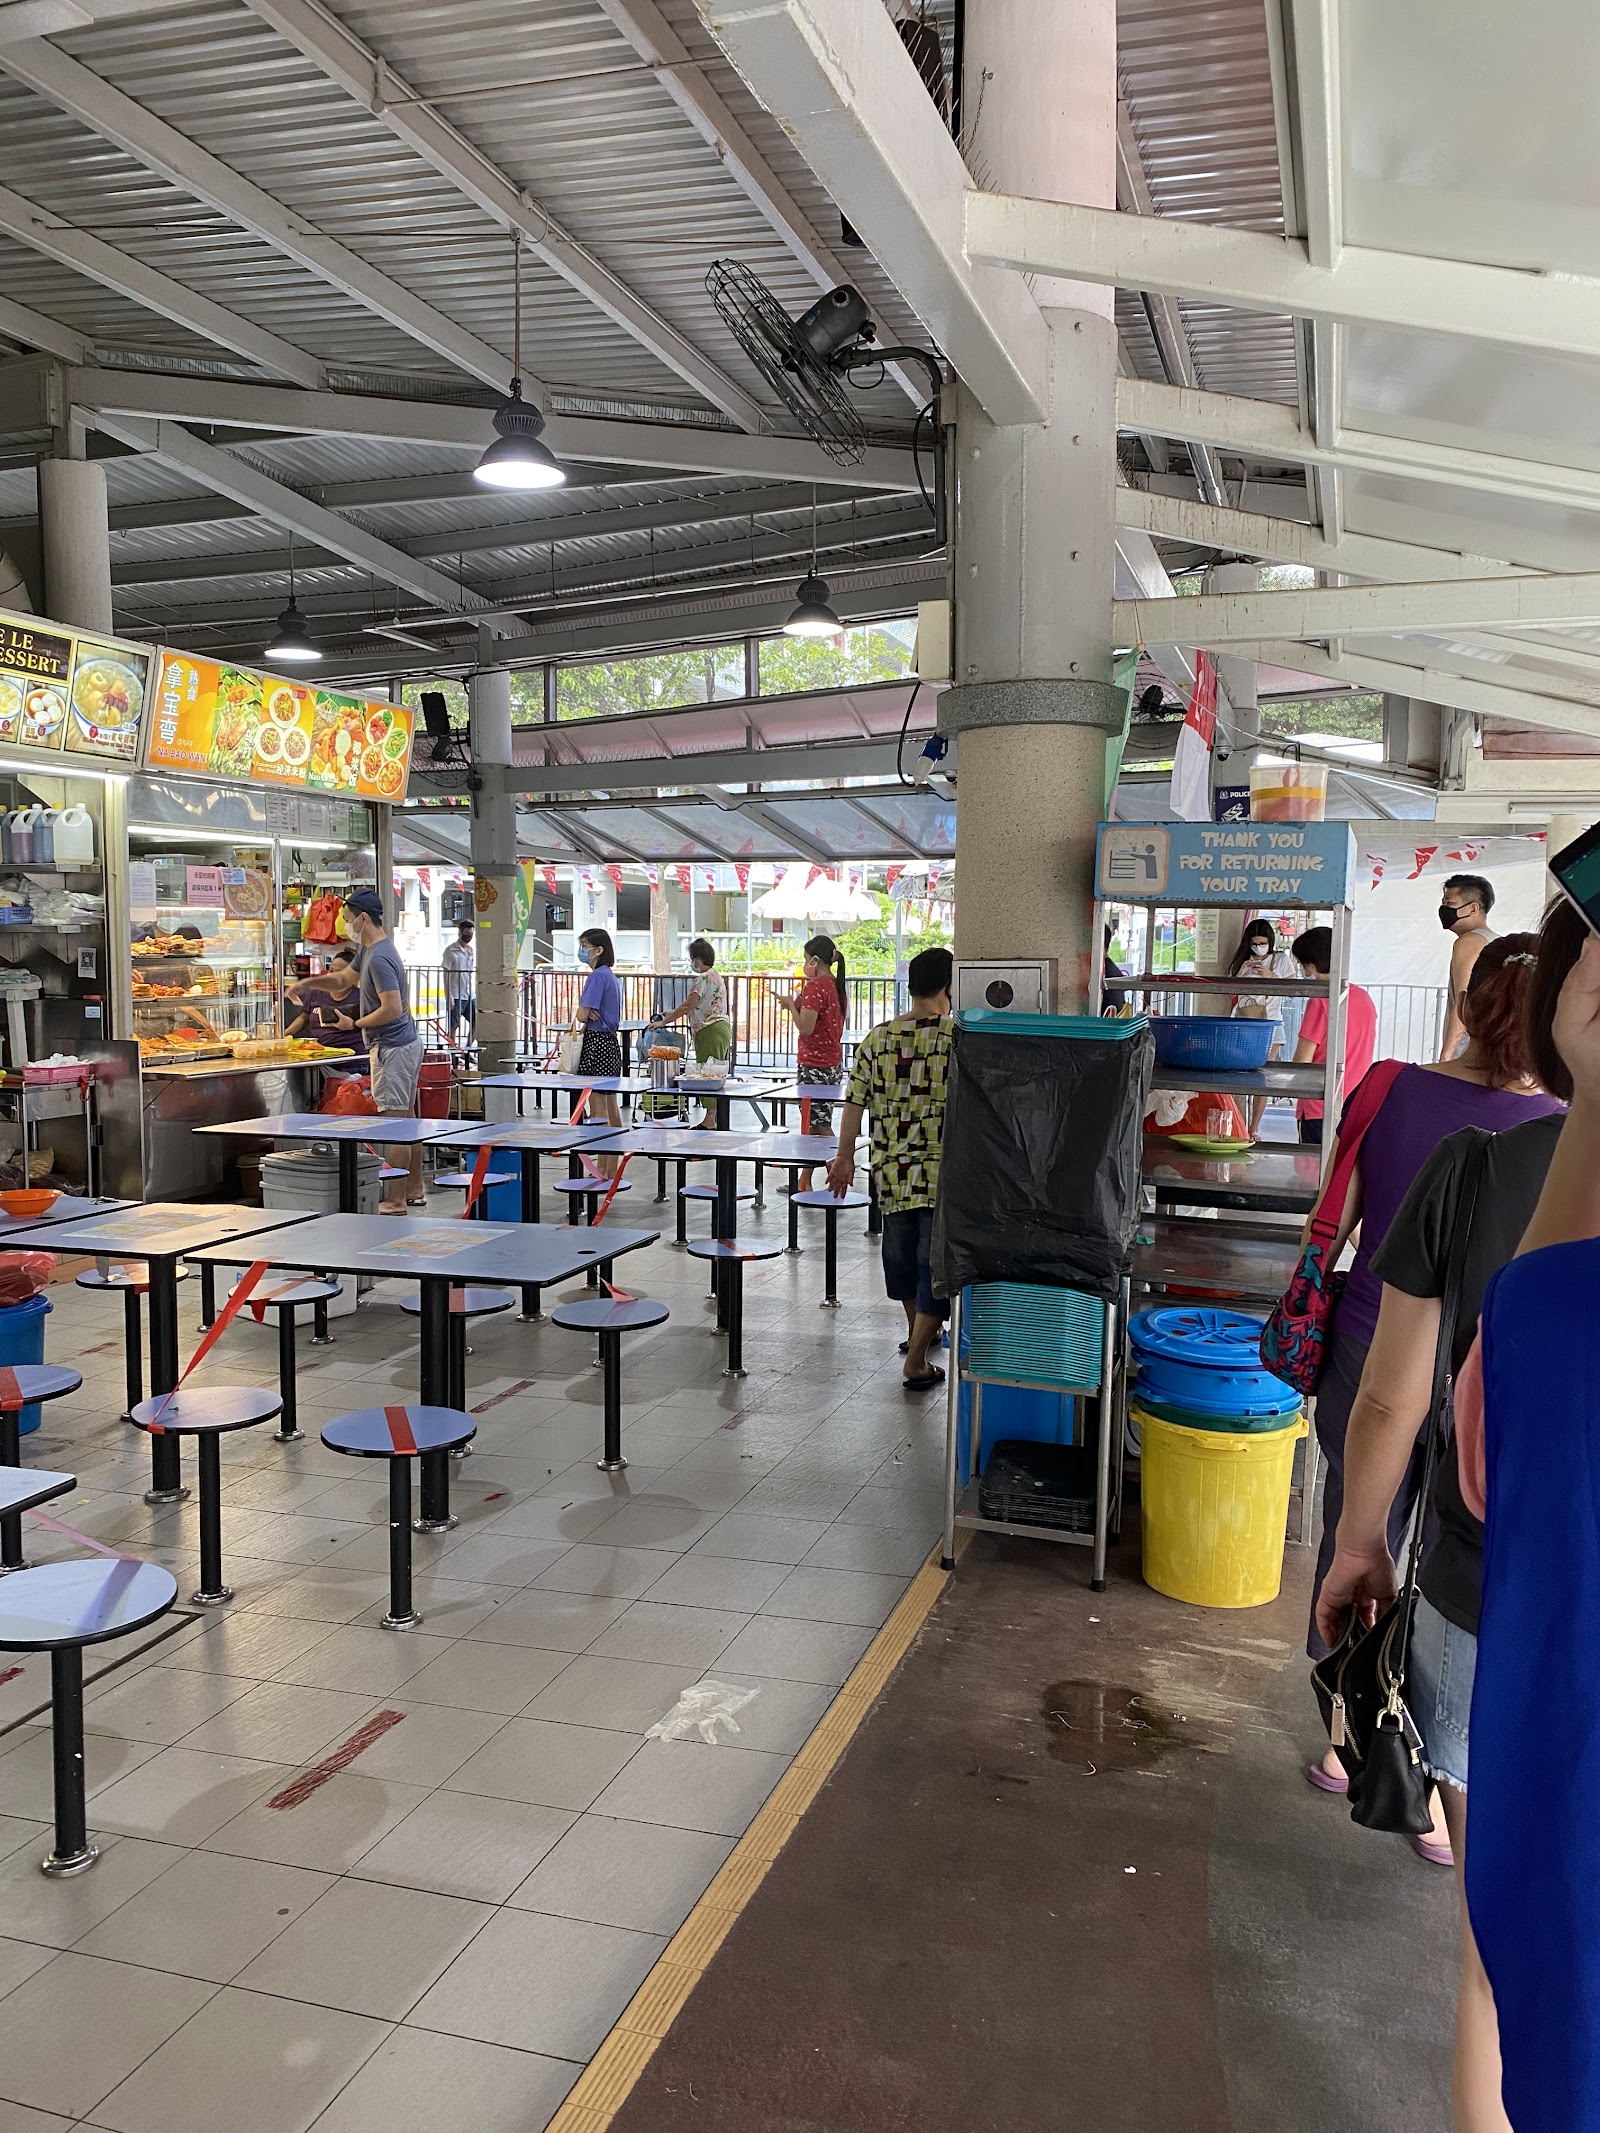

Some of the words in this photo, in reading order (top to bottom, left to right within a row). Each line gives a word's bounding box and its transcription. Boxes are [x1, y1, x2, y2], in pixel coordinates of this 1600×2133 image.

[11, 630, 35, 650] LE
[157, 747, 169, 757] NA
[170, 749, 187, 760] BAO
[188, 752, 206, 762] WAN
[1201, 831, 1261, 848] THANK
[1268, 832, 1304, 848] YOU
[1179, 854, 1214, 871] FOR
[1220, 854, 1324, 872] RETURNING
[1200, 876, 1249, 893] YOUR
[1255, 876, 1302, 894] TRAY
